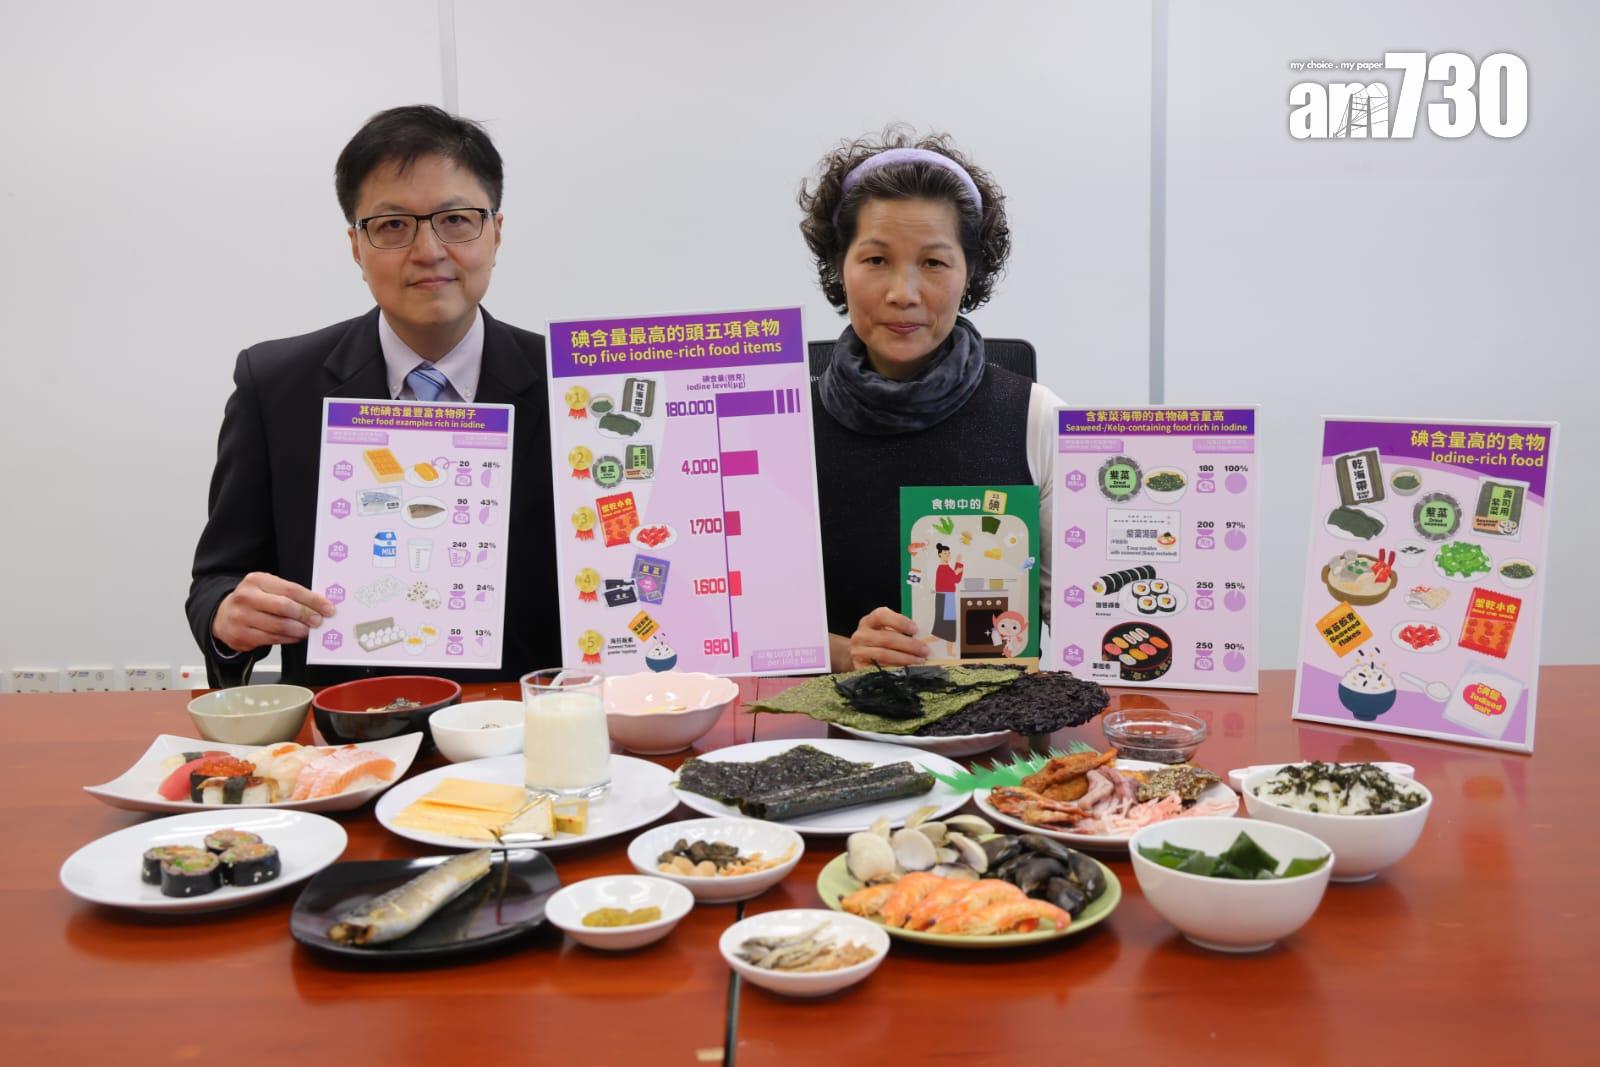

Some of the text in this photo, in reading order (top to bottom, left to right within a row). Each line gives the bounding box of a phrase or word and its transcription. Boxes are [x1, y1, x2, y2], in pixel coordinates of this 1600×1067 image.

[570, 318, 780, 348] 碘含量最高的頭五項食物
[571, 341, 782, 366] Top five iodine-rich food items
[1086, 410, 1224, 422] 含紫菜海帶的食物碘含量高
[352, 417, 375, 425] Other
[395, 419, 433, 428] examples
[434, 420, 450, 428] rich
[451, 420, 459, 428] in
[461, 420, 486, 429] iodine
[1411, 430, 1546, 451] 碘含量高的食物
[577, 452, 585, 463] 2
[1432, 451, 1544, 467] Iodine-rich food
[931, 498, 981, 510] 食物中的
[1426, 507, 1448, 518] 紫菜
[587, 636, 594, 647] 5
[704, 638, 730, 655] 980
